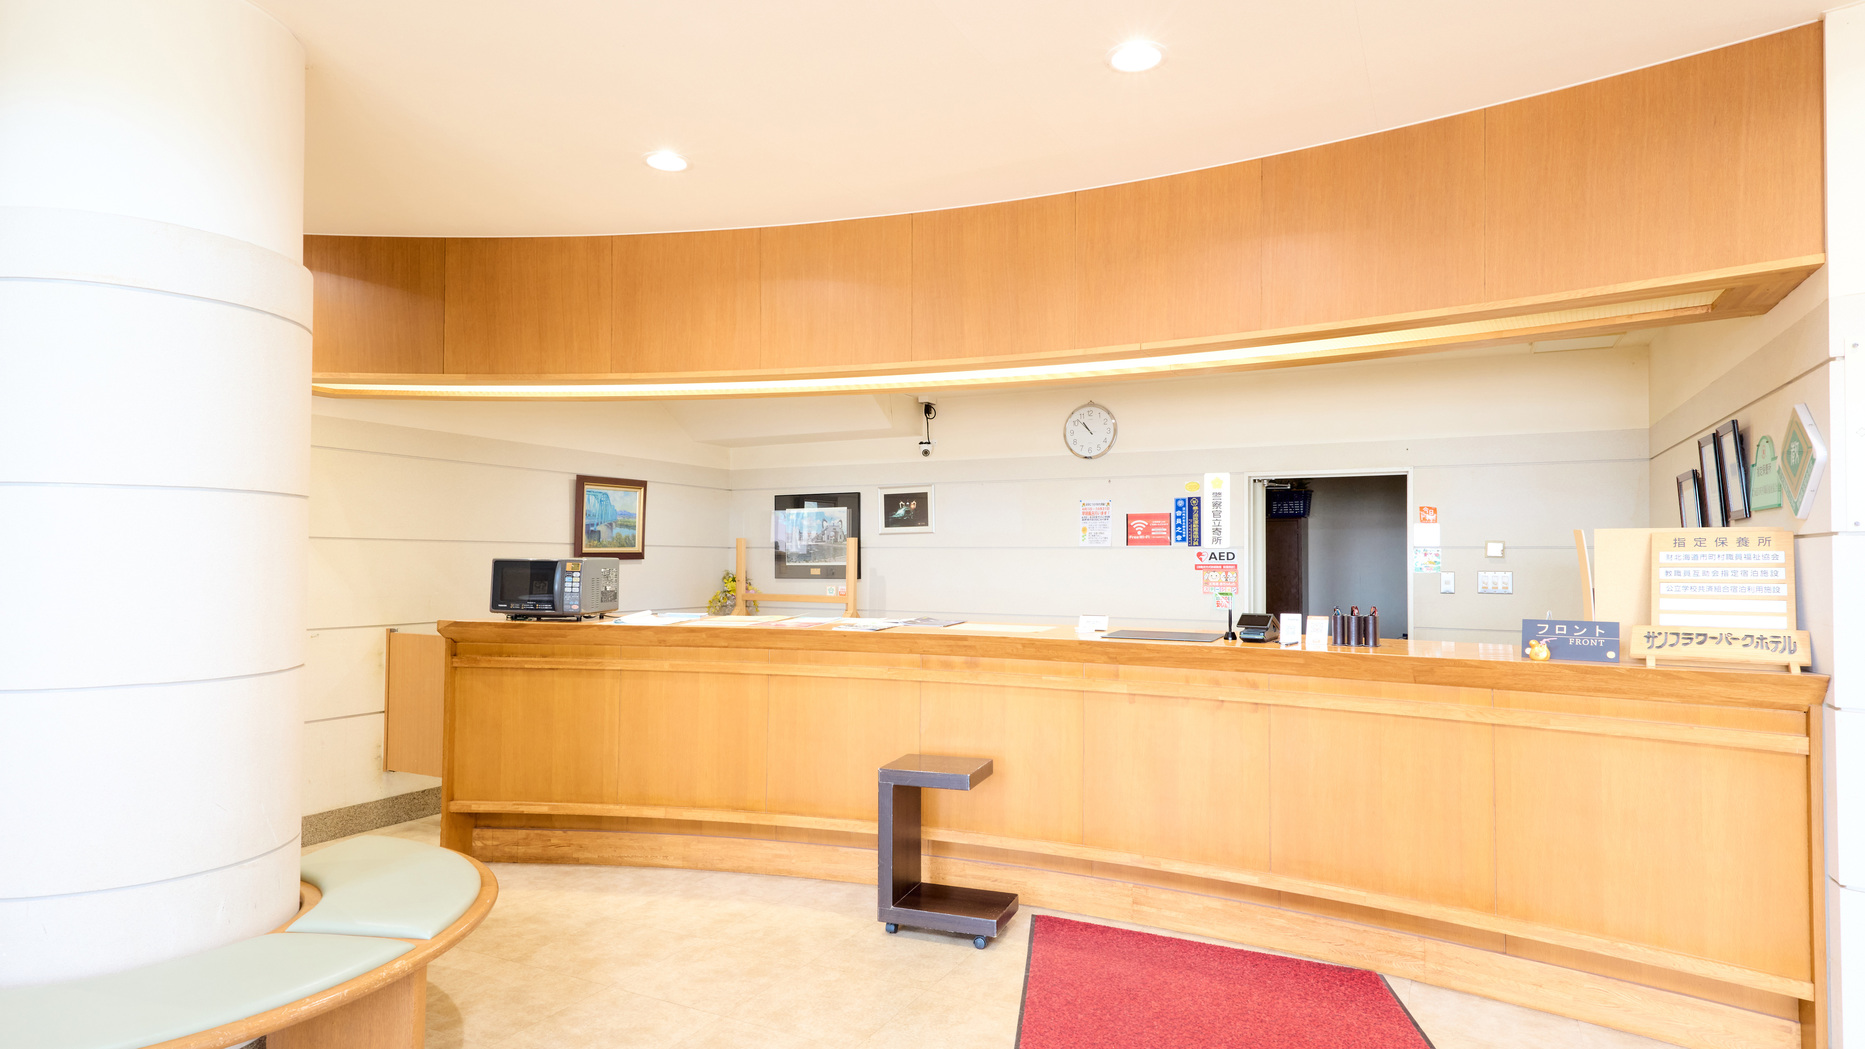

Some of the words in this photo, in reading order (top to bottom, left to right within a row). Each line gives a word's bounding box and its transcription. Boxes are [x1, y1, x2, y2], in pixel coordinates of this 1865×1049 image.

[1211, 492, 1222, 545] 警察官立寄所
[1673, 536, 1772, 548] 指定保養所
[1209, 551, 1236, 561] AED
[1665, 569, 1779, 578] 教職員互助会指定宿泊施設
[1666, 585, 1781, 594] 公立学校共済組合宿泊利用施設
[1536, 623, 1606, 637] フロント
[1569, 637, 1605, 647] FRONT
[1644, 631, 1797, 655] サンフラワーパークホテル
